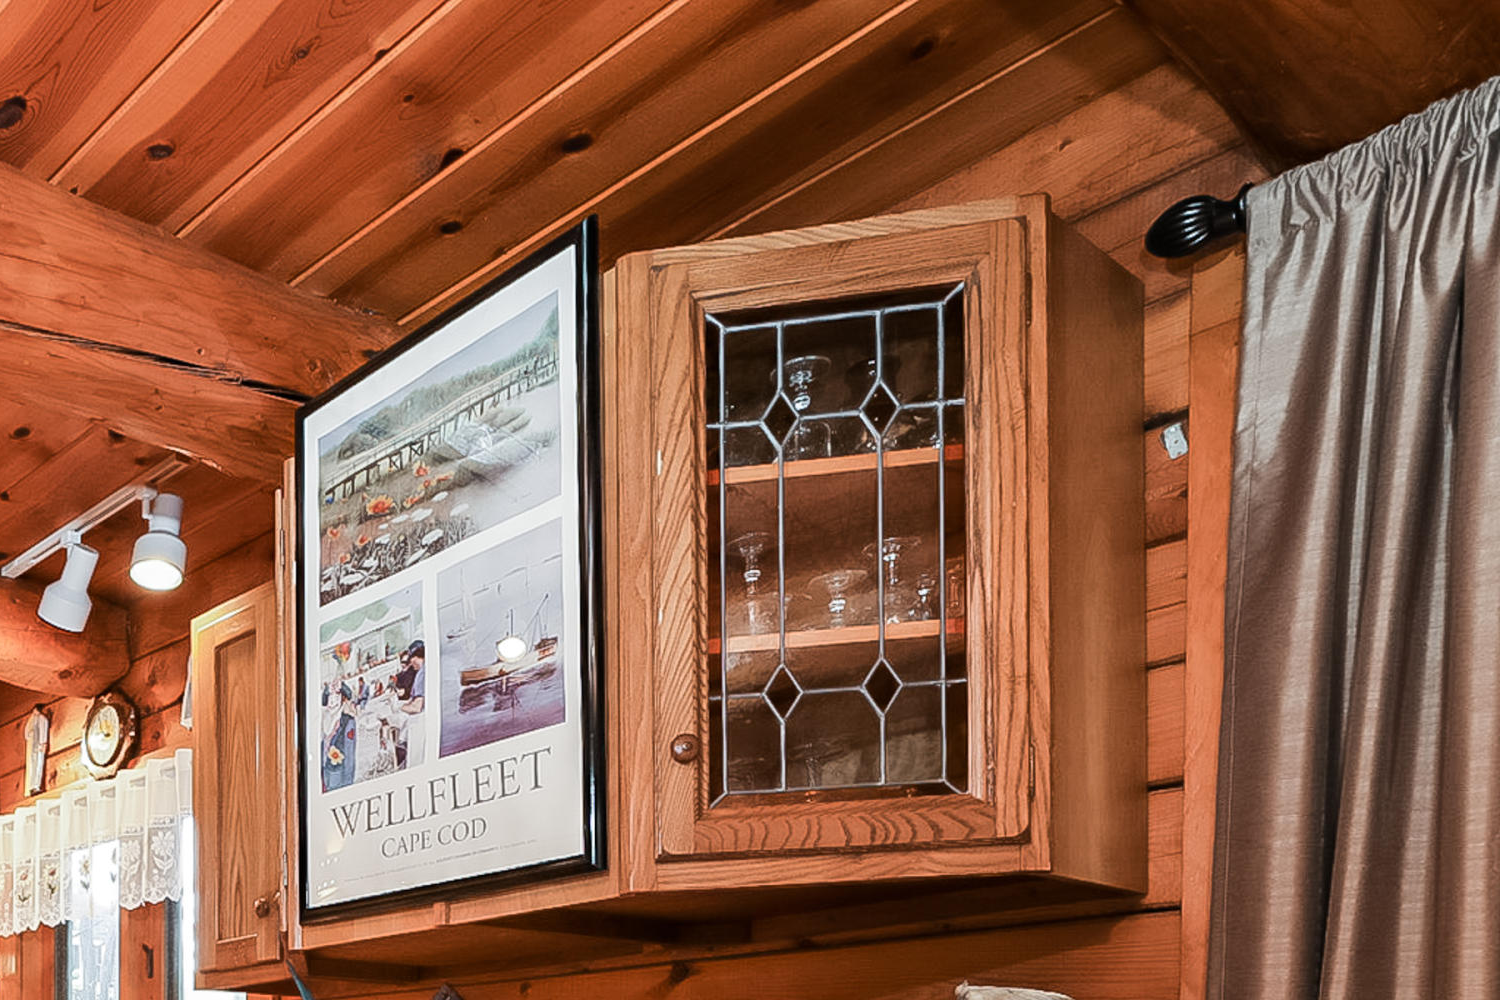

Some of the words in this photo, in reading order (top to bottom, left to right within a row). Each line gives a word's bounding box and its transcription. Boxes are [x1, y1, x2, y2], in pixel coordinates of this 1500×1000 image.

[331, 747, 552, 839] WELLFLEET
[381, 827, 433, 859] CAPE
[437, 817, 488, 846] COD
